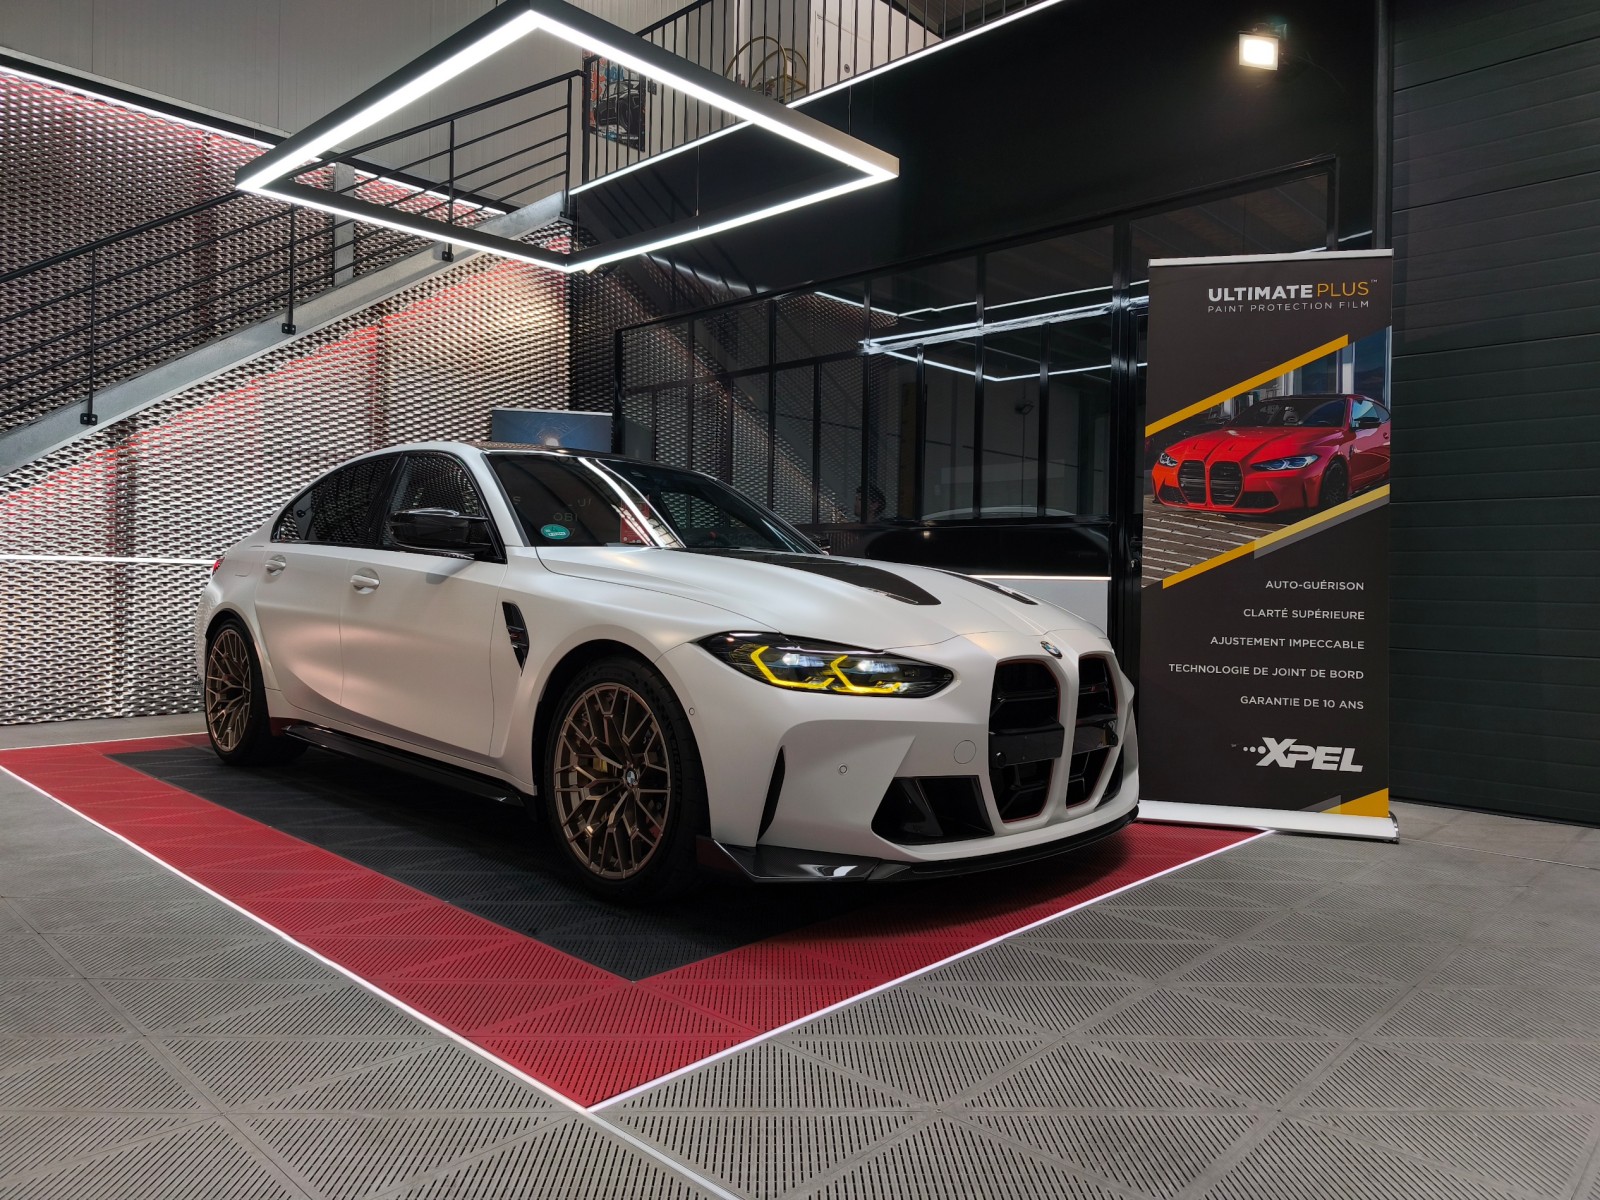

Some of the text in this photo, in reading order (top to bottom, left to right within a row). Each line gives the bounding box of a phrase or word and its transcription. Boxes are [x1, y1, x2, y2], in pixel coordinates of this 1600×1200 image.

[1208, 284, 1313, 302] ULTIMATE
[1316, 281, 1369, 298] PLUS
[1207, 300, 1369, 314] PAINT PROTECTION FILM
[1265, 578, 1365, 591] AUTO-GUÉRISON
[1243, 607, 1365, 620] CLARTÉ SUPÉRIEURE
[1210, 636, 1365, 650] AJUSTEMENT IMPECCABLE
[1168, 663, 1364, 680] TECHNOLOGIE DE JOINT DE BORD
[1240, 695, 1364, 710] GARANTIE DE 10 ANS
[1256, 736, 1364, 773] XPEL
